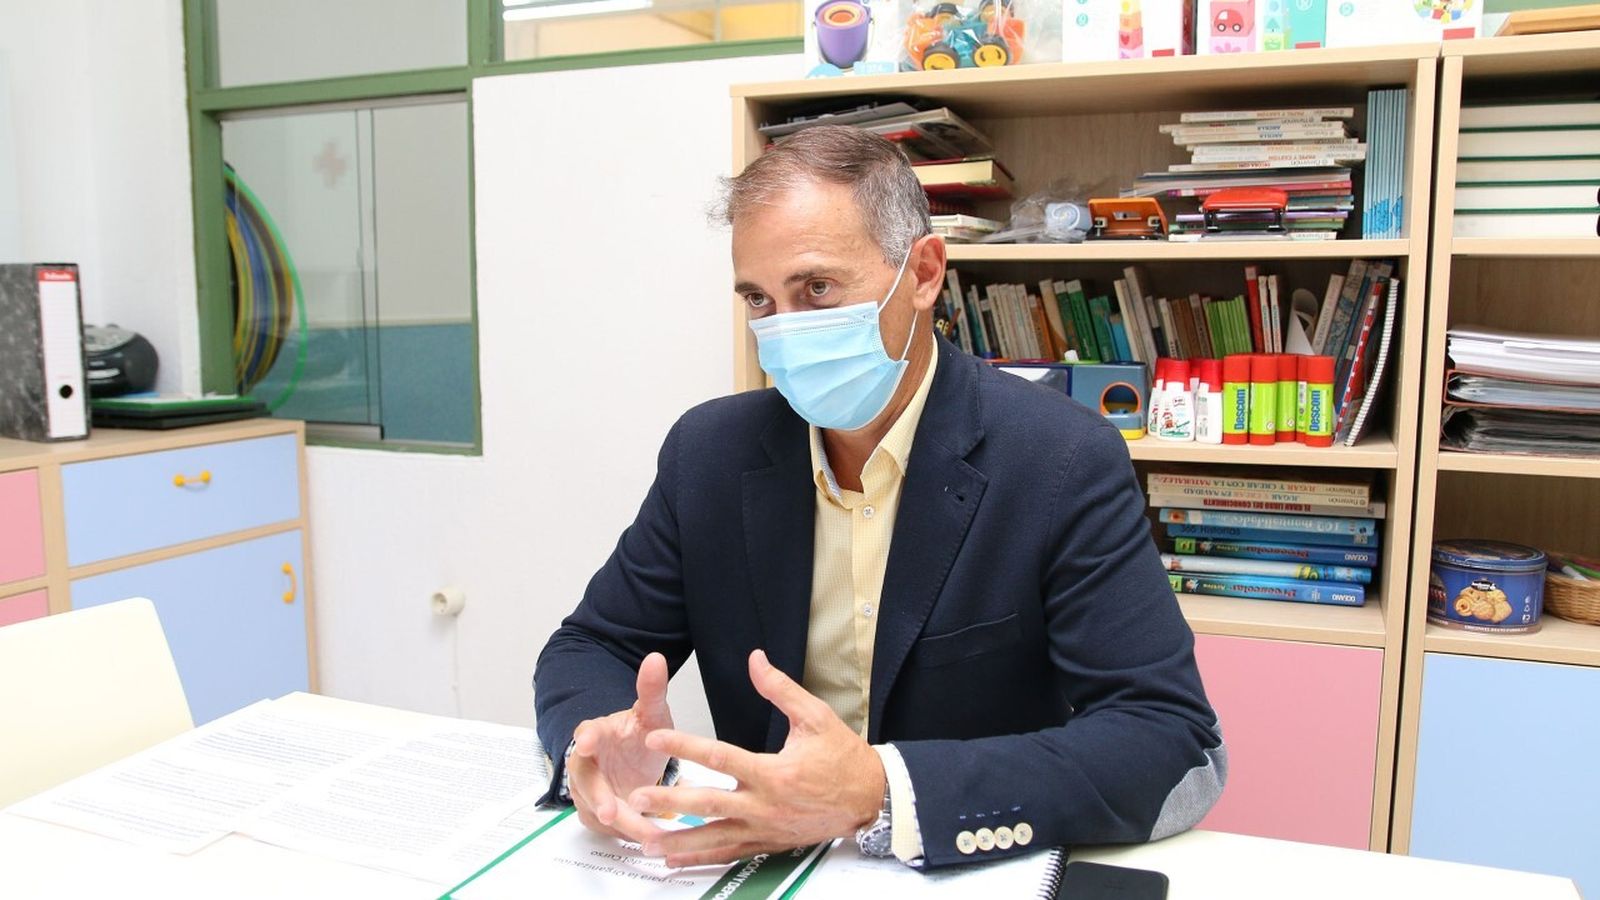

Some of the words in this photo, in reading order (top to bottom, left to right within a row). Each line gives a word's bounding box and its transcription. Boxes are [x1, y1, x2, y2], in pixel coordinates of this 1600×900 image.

[1233, 389, 1246, 432] Descom
[1309, 389, 1322, 433] Descom
[1226, 481, 1245, 489] CON
[1247, 482, 1277, 491] CREAR
[1287, 484, 1316, 493] JUGAR
[1183, 488, 1219, 497] NAVIDAD
[1234, 492, 1262, 500] CREAR
[1271, 494, 1300, 502] JUGAR
[1203, 499, 1251, 509] CONOCIMIENTO
[1252, 502, 1263, 510] DEL
[1264, 502, 1283, 511] LIBRO
[1284, 503, 1303, 512] GRAN
[1344, 553, 1369, 562] OCEANO
[1331, 593, 1356, 603] OCEANO
[590, 851, 626, 863] Curso
[553, 857, 626, 877] Organización
[641, 874, 668, 885] para
[668, 878, 696, 888] Guía
